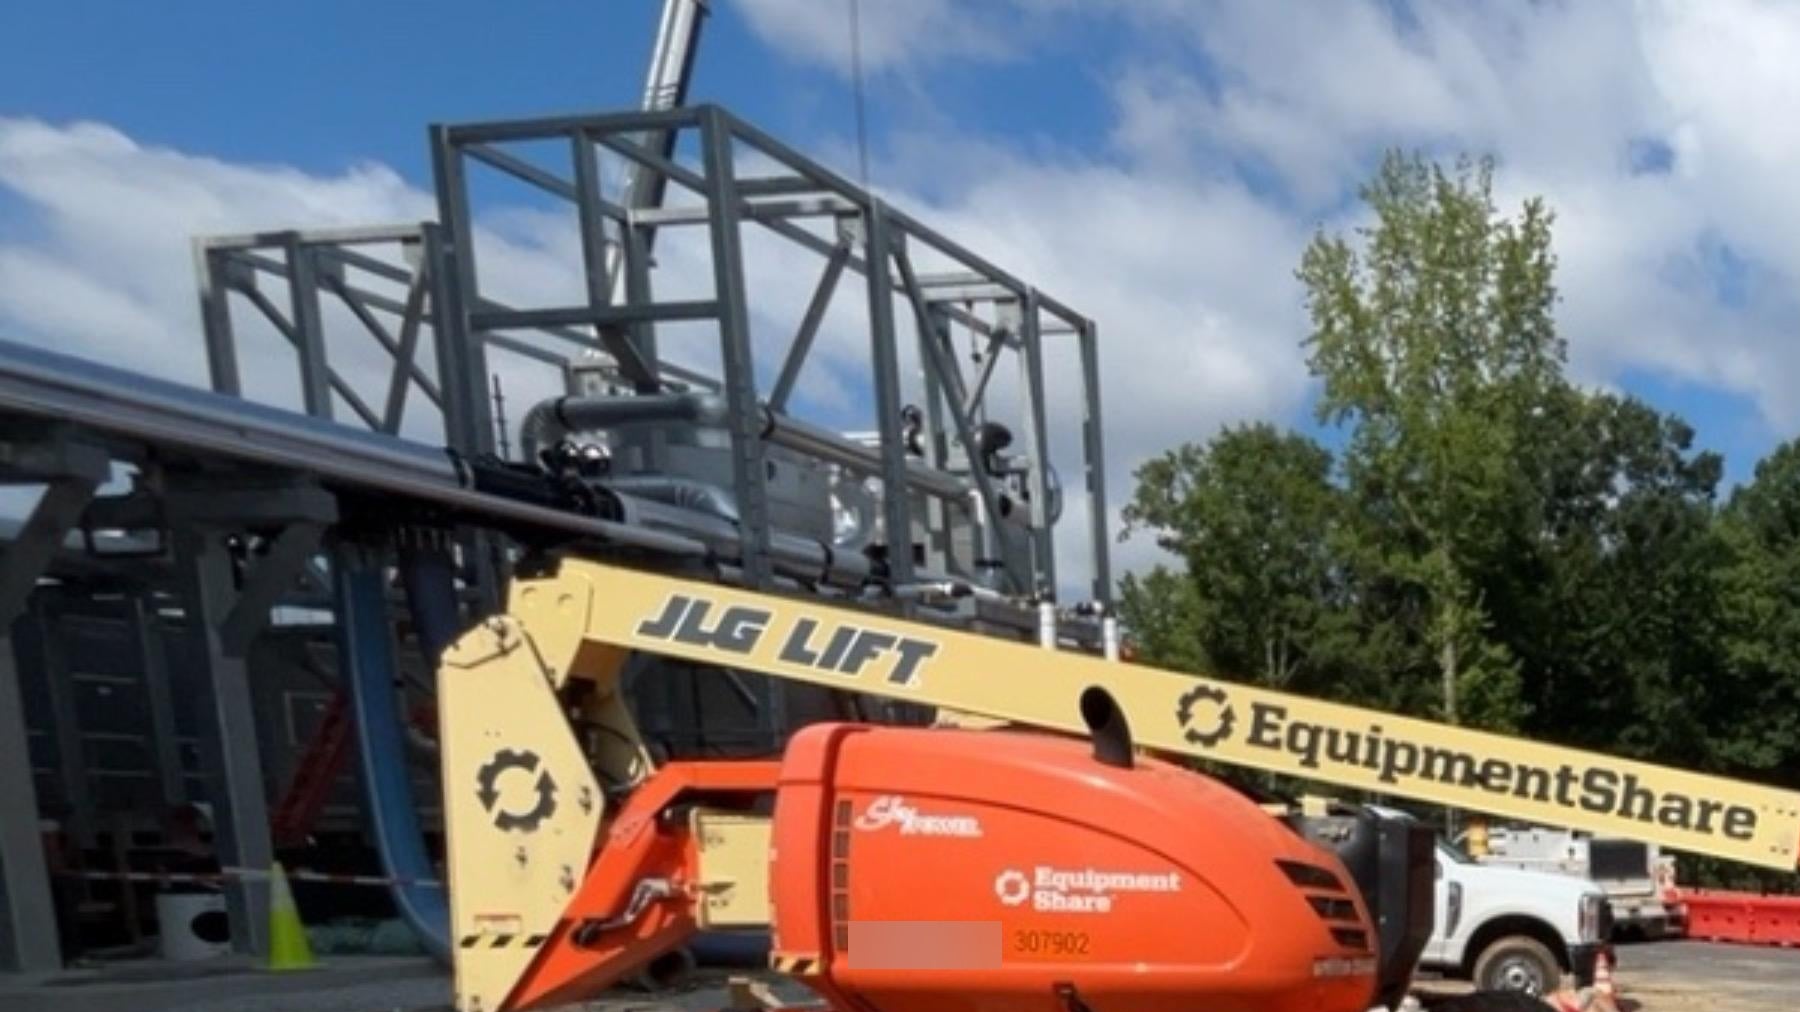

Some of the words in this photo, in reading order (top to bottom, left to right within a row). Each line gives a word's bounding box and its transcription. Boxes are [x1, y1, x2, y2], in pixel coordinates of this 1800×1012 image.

[636, 594, 773, 656] JLG
[777, 616, 940, 686] LIFT
[1246, 701, 1758, 842] EquipmentShare
[1033, 865, 1182, 893] Equipment
[1033, 890, 1112, 913] Share
[1013, 929, 1091, 954] 307902
